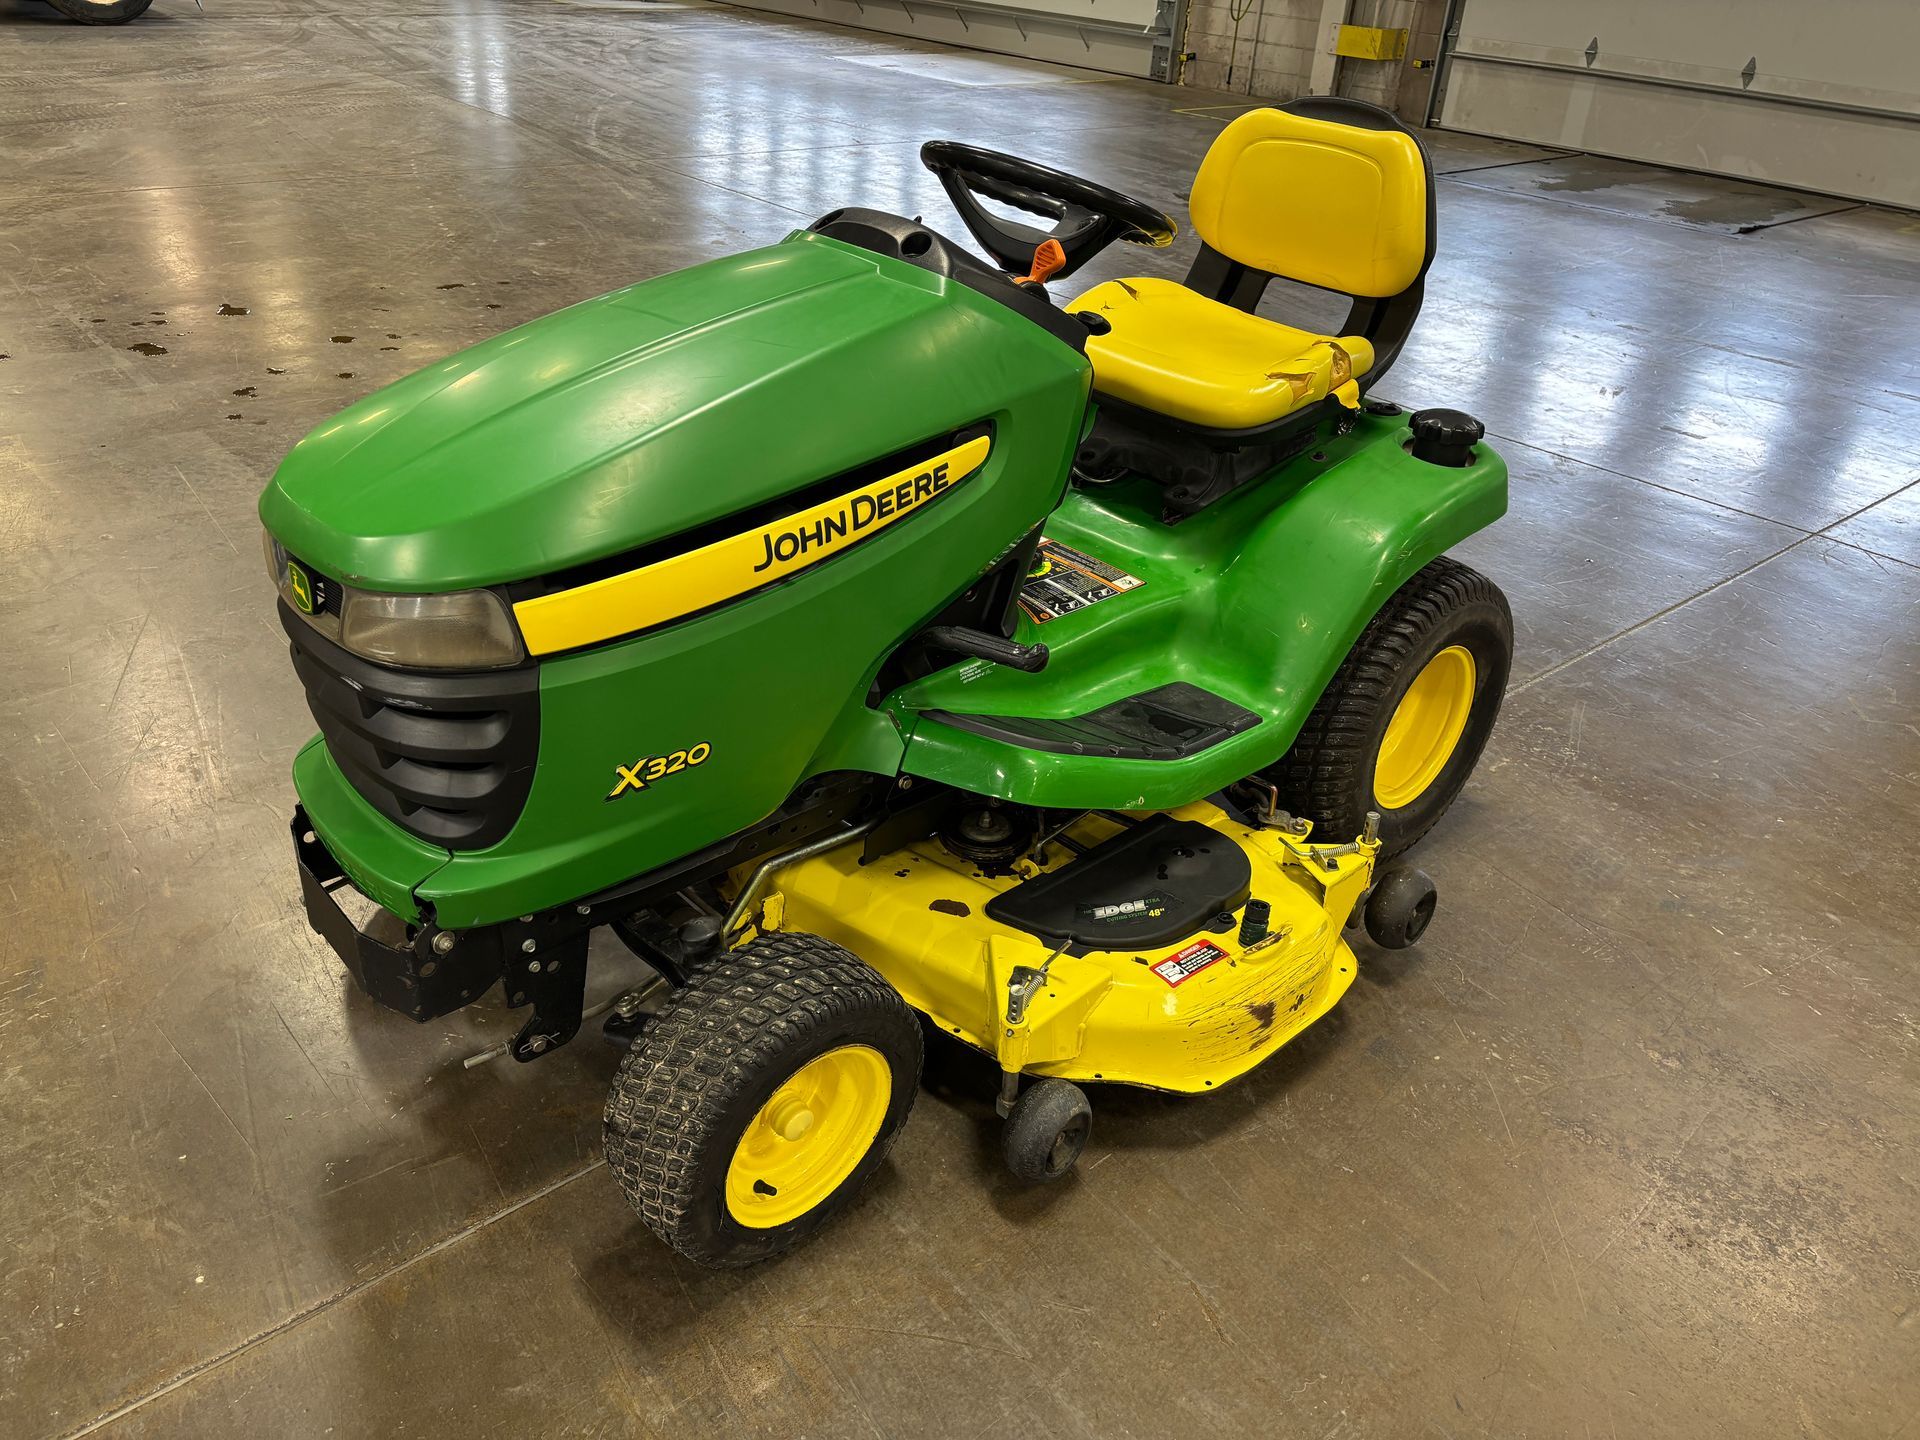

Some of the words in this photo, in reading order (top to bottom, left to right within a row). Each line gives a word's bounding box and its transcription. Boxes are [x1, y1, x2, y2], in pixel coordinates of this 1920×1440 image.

[754, 511, 847, 572] JOHN
[851, 463, 949, 530] DEERE
[604, 741, 712, 801] X320
[1093, 900, 1146, 919] EDGE
[1148, 908, 1165, 917] 48"
